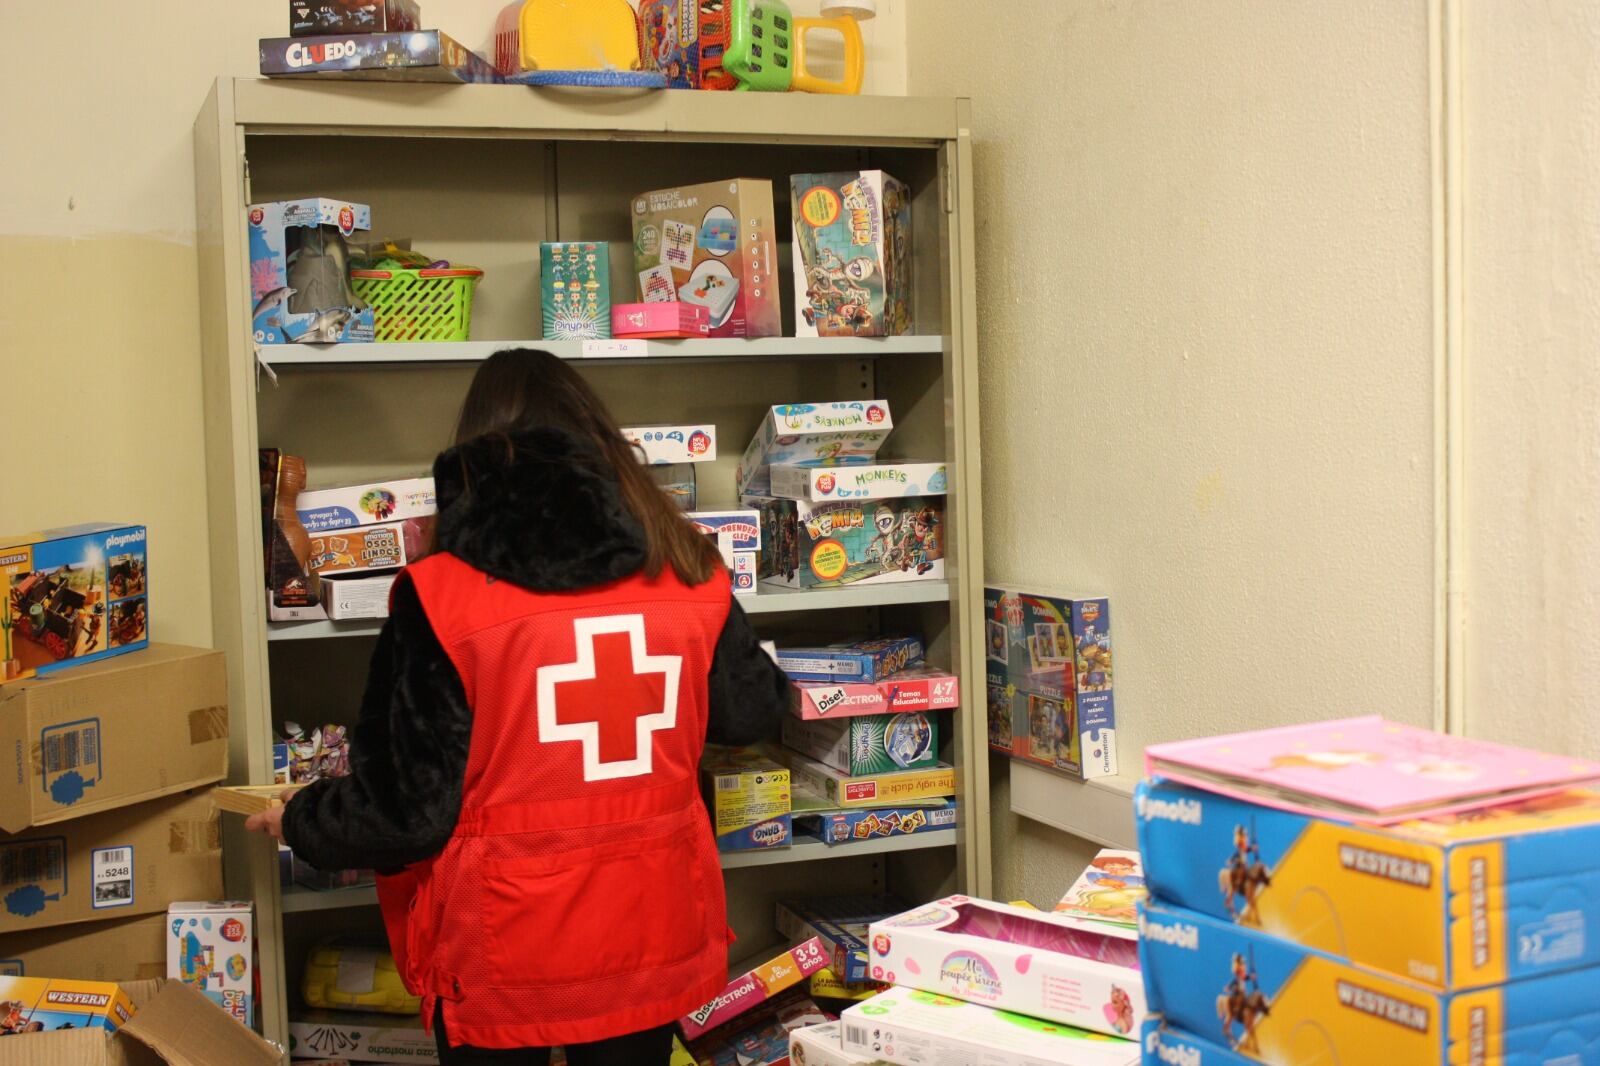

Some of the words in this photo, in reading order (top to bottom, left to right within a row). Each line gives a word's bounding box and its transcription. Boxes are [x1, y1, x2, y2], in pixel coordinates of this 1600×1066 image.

[286, 40, 356, 68] CLUEDO
[815, 414, 862, 426] MONKEYS
[806, 432, 881, 444] MONKEYS
[856, 470, 908, 485] MONKEYS
[716, 523, 758, 538] PRENDER
[106, 530, 146, 550] playmobil
[366, 540, 394, 548] OSOS
[733, 533, 750, 542] CLES
[362, 548, 400, 560] LINDOS
[818, 689, 844, 710] Diset
[839, 694, 883, 706] LECTRON
[893, 698, 928, 706] Educativos
[933, 696, 954, 704] años
[916, 779, 935, 788] ugly
[938, 779, 956, 788] The
[755, 825, 780, 839] BANG
[1340, 844, 1431, 886] WESTERN
[802, 955, 823, 970] años
[48, 992, 109, 1005] WESTERN
[714, 982, 756, 1010] LECTRON
[116, 1004, 130, 1021] WEST
[1338, 982, 1428, 1030] WESTERN
[368, 1046, 414, 1056] mostacho
